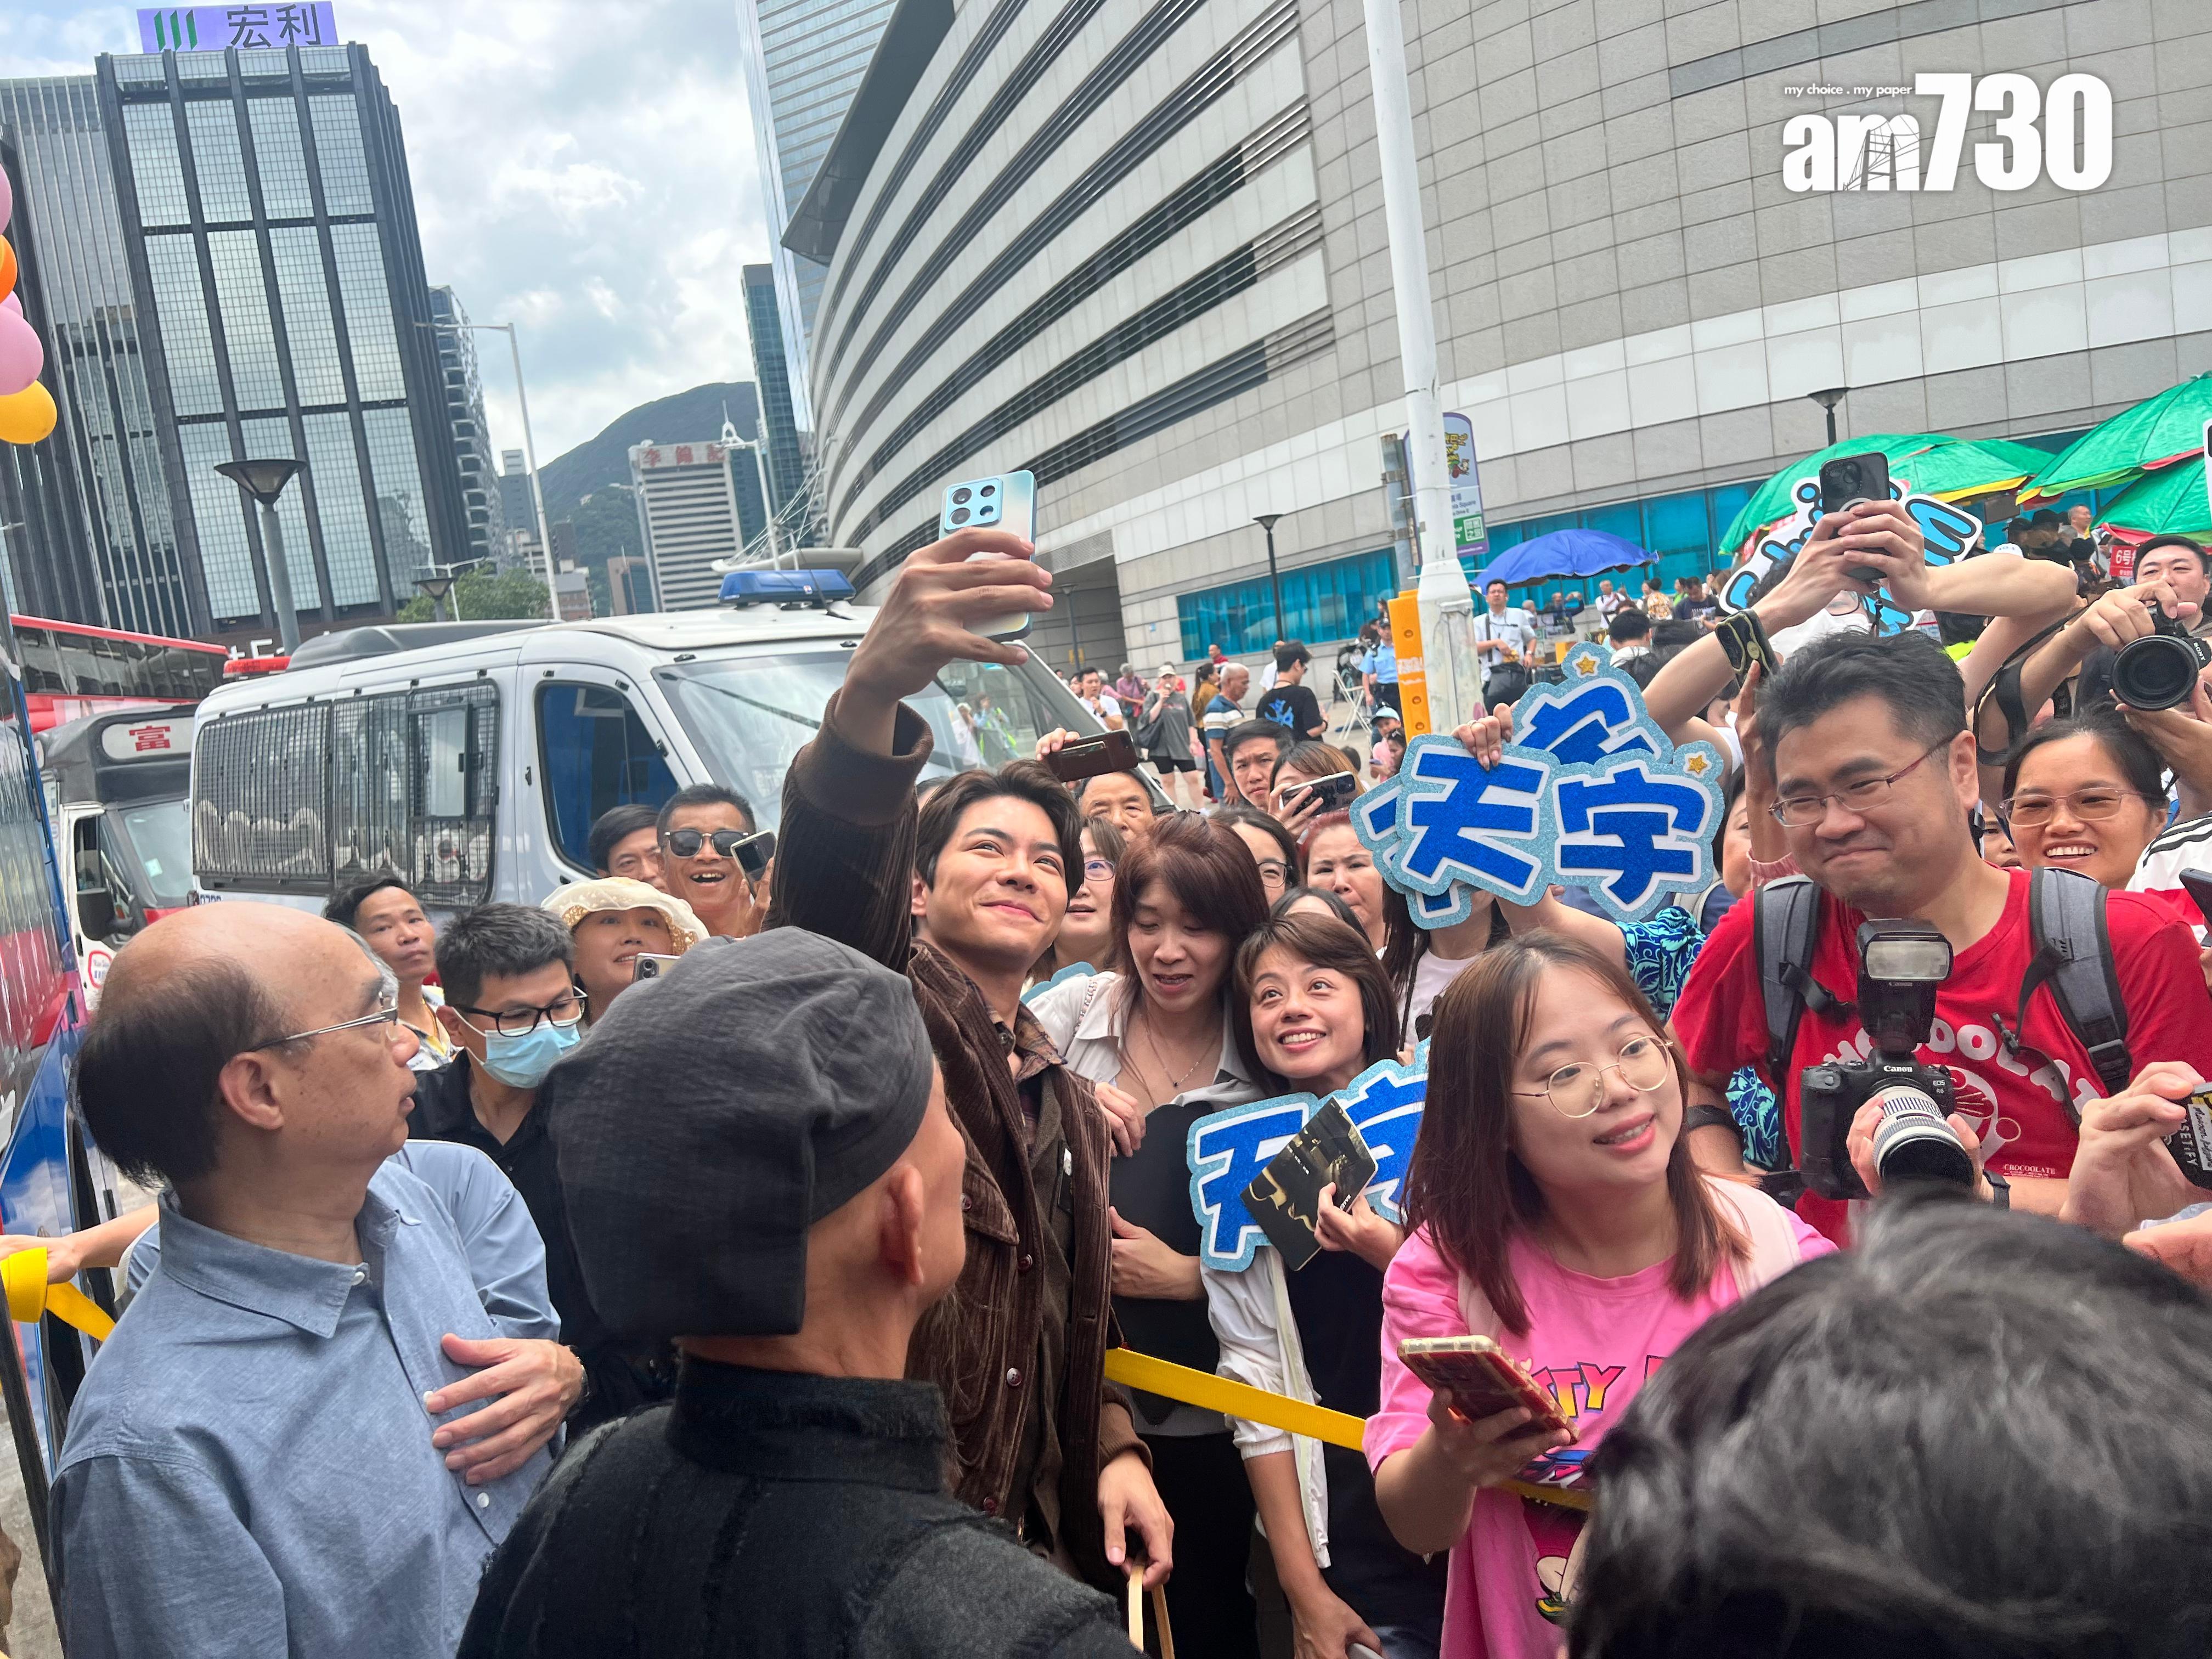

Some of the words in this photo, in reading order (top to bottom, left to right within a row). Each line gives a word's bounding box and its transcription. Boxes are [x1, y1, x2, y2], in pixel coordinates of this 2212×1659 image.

[227, 3, 321, 48] 宏利
[2193, 642, 2206, 661] SONY
[128, 725, 171, 751] 富
[1406, 753, 1705, 905] 天宇
